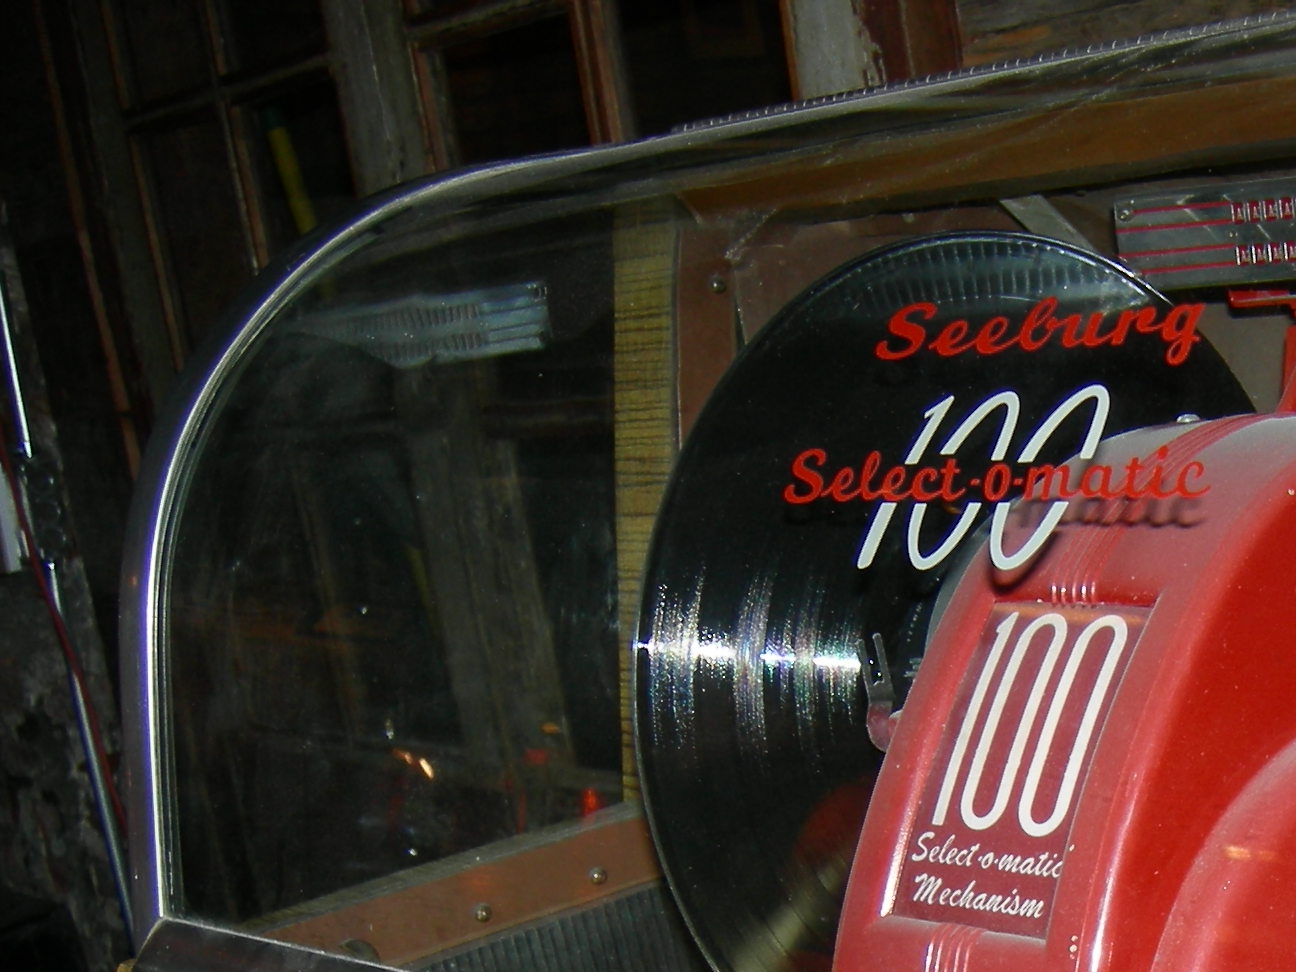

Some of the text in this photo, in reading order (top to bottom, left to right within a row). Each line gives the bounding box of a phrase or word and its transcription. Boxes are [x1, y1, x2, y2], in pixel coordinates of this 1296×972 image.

[875, 296, 1206, 366] Seeburg
[857, 384, 1111, 571] 100
[932, 611, 1128, 838] 100
[913, 873, 1045, 919] Mechanism
